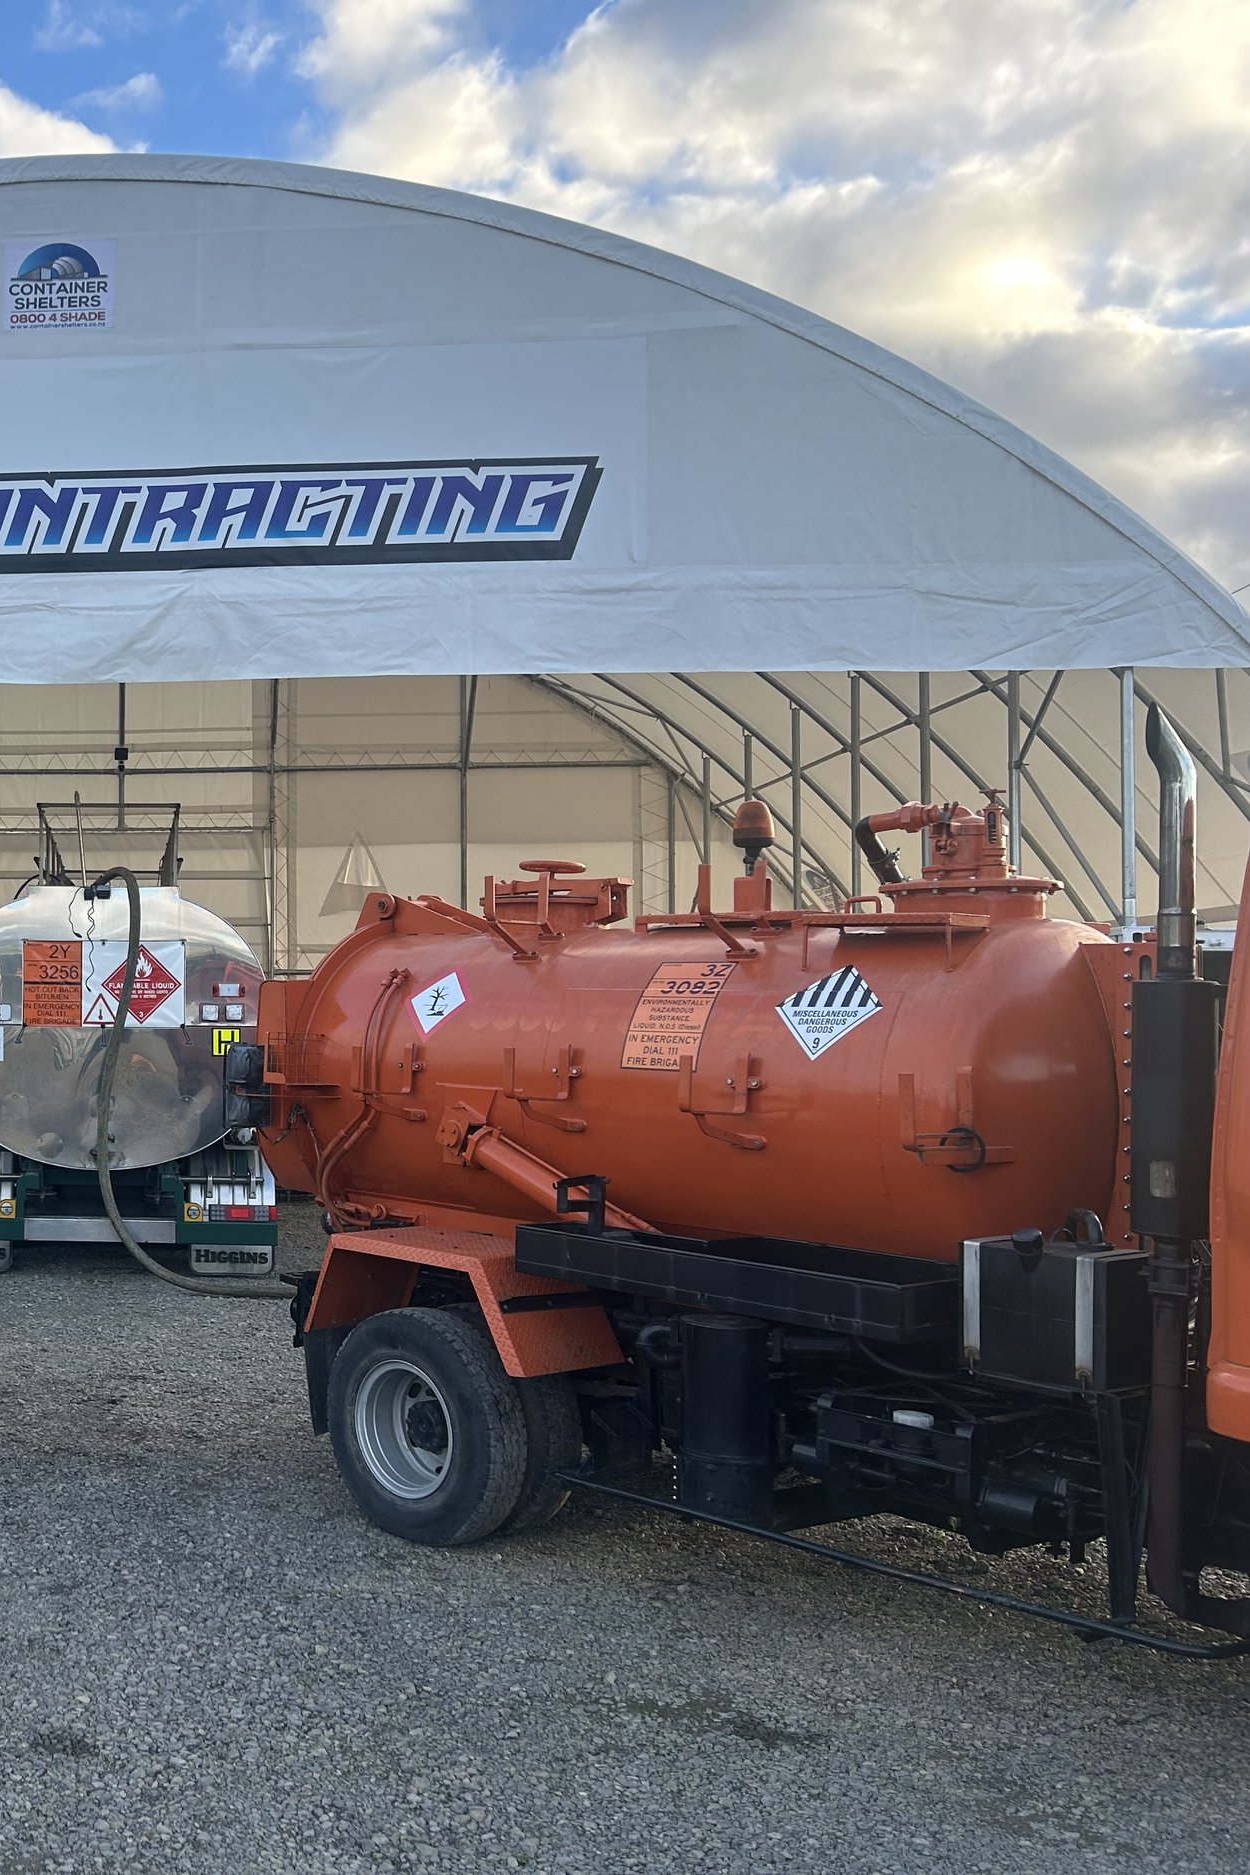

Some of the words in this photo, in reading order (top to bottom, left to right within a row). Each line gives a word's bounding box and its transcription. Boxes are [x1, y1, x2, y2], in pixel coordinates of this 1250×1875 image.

[9, 281, 108, 296] CONTAINER
[14, 295, 101, 310] SHELTERS
[10, 313, 46, 324] 0800
[49, 313, 57, 323] 4
[60, 311, 106, 323] SHADE
[49, 944, 71, 959] 2Y
[39, 965, 79, 980] 3256
[700, 963, 733, 977] 3Z
[660, 980, 721, 995] 3082
[792, 1010, 859, 1018] MISCELLANEOUS
[798, 1018, 847, 1026] DANGEROUS
[806, 1026, 834, 1034] GOODS
[628, 1034, 637, 1042] IN
[640, 1034, 699, 1045] EMERGENCY
[812, 1037, 820, 1049] 9
[643, 1046, 664, 1055] DIAL
[668, 1047, 678, 1055] 111
[626, 1057, 647, 1066] FIRE
[650, 1057, 678, 1067] BRIGA
[195, 1249, 269, 1264] HIGGINS
